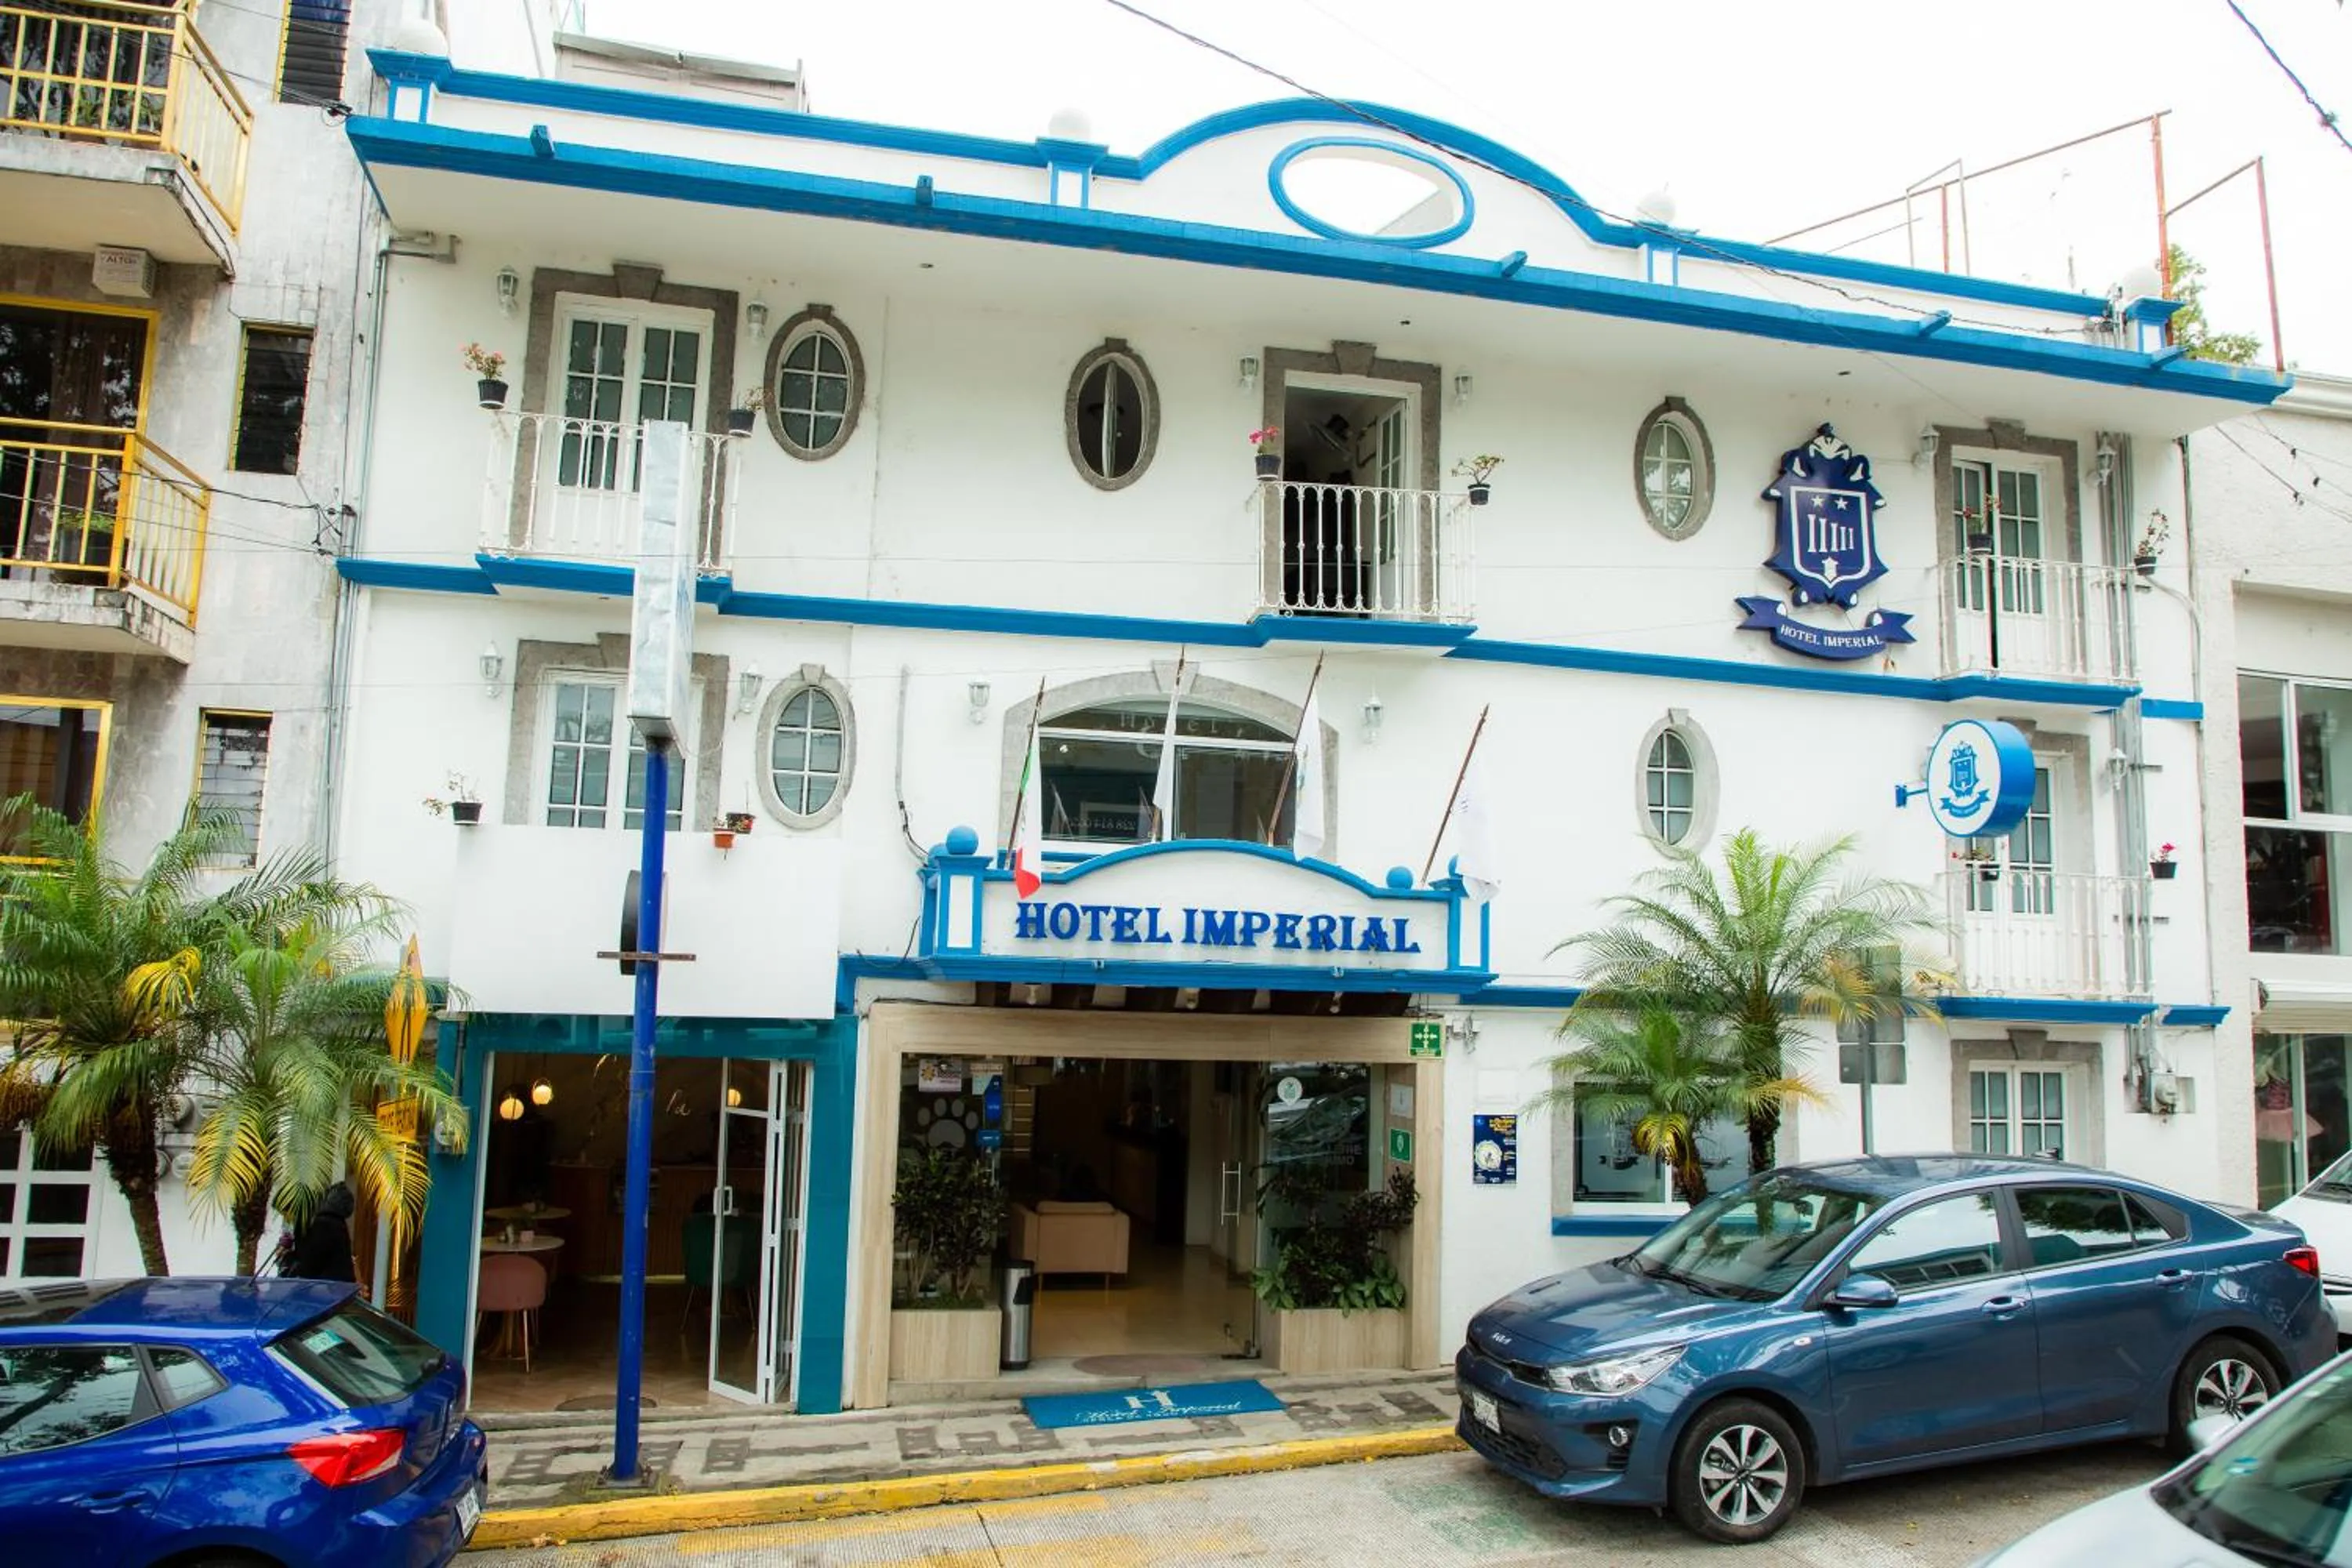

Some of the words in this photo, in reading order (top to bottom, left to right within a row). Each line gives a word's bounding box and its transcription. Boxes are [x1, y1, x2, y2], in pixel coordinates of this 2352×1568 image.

[1780, 624, 1820, 645] HOTEL
[1824, 634, 1884, 648] IMPERIAL
[1014, 902, 1173, 943] HOTEL
[1181, 908, 1421, 953] IMPERIAL
